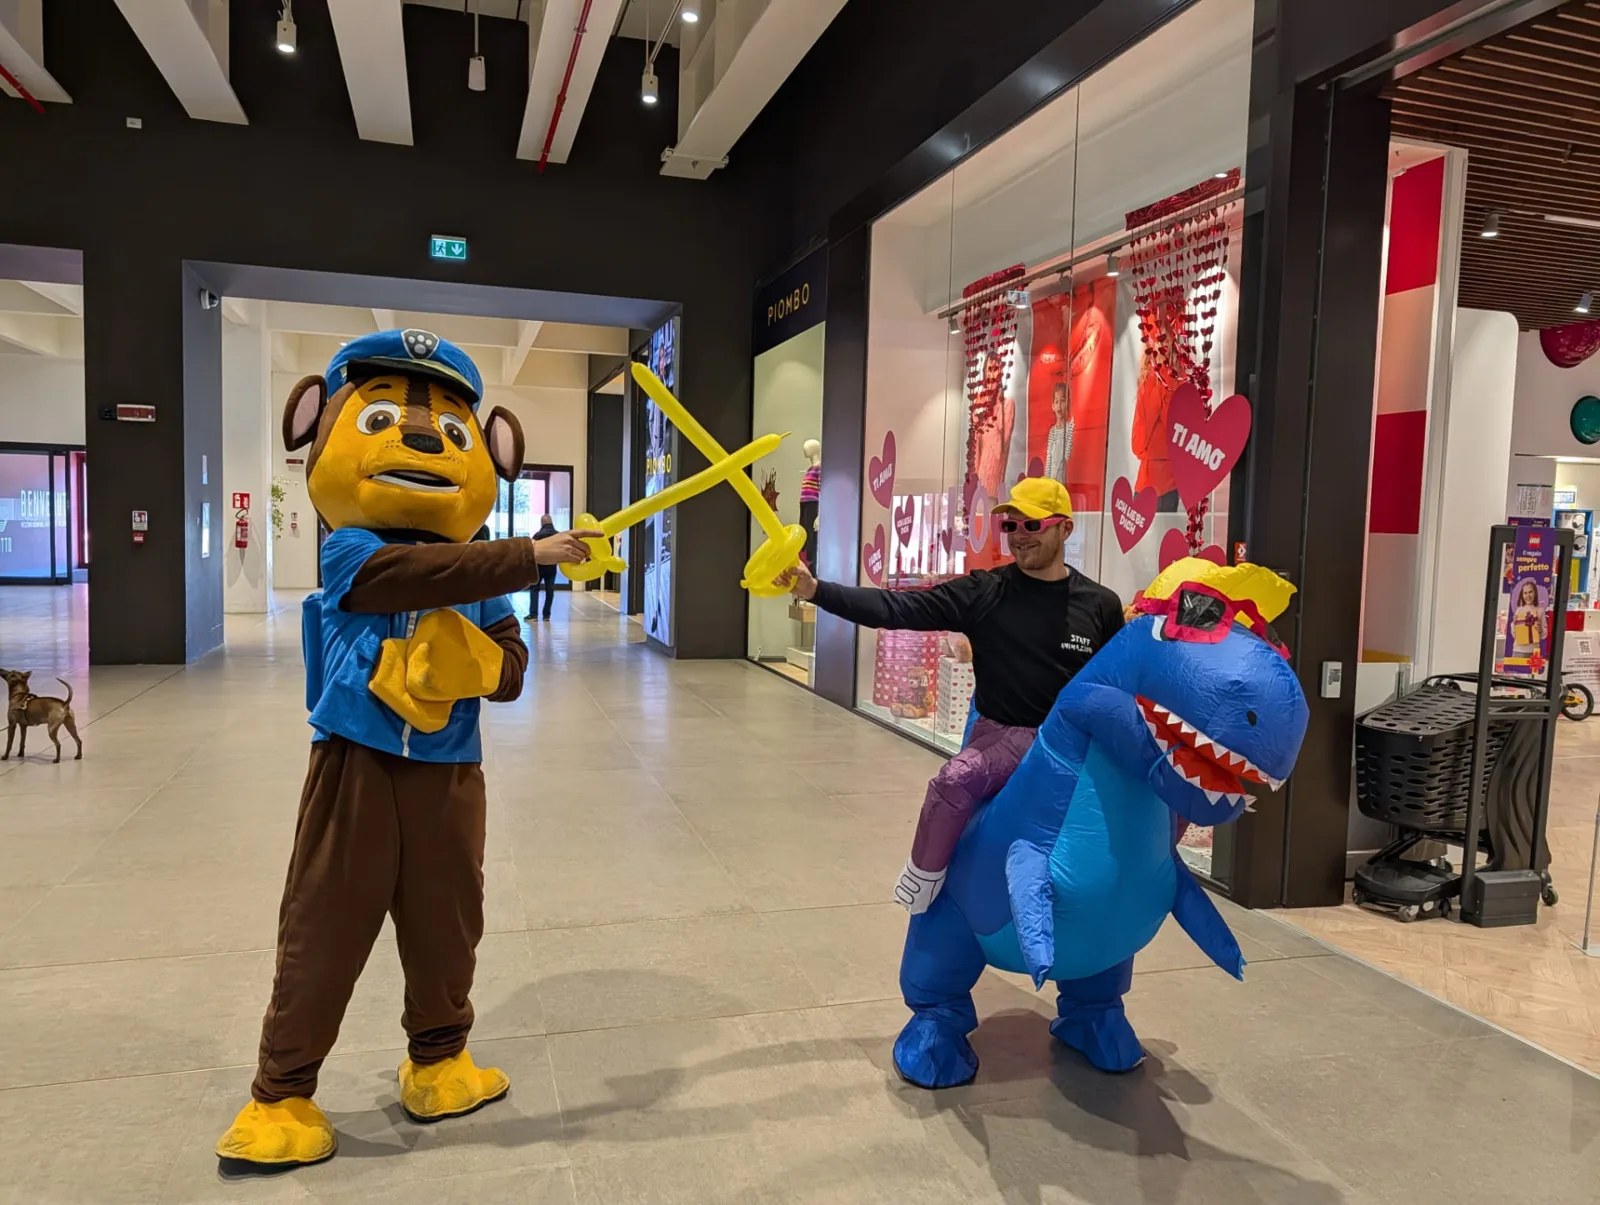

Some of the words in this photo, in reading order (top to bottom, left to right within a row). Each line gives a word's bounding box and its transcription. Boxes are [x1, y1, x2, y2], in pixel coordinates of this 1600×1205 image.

[768, 283, 809, 326] PIOMBO
[1172, 422, 1188, 447] TI
[1185, 433, 1226, 471] AMO
[1115, 498, 1128, 515] ICH
[1126, 504, 1146, 529] LIEBE
[1119, 514, 1137, 536] DICH
[1516, 556, 1537, 564] sempre
[1518, 563, 1549, 574] perfetto
[1070, 633, 1091, 646] STAFF
